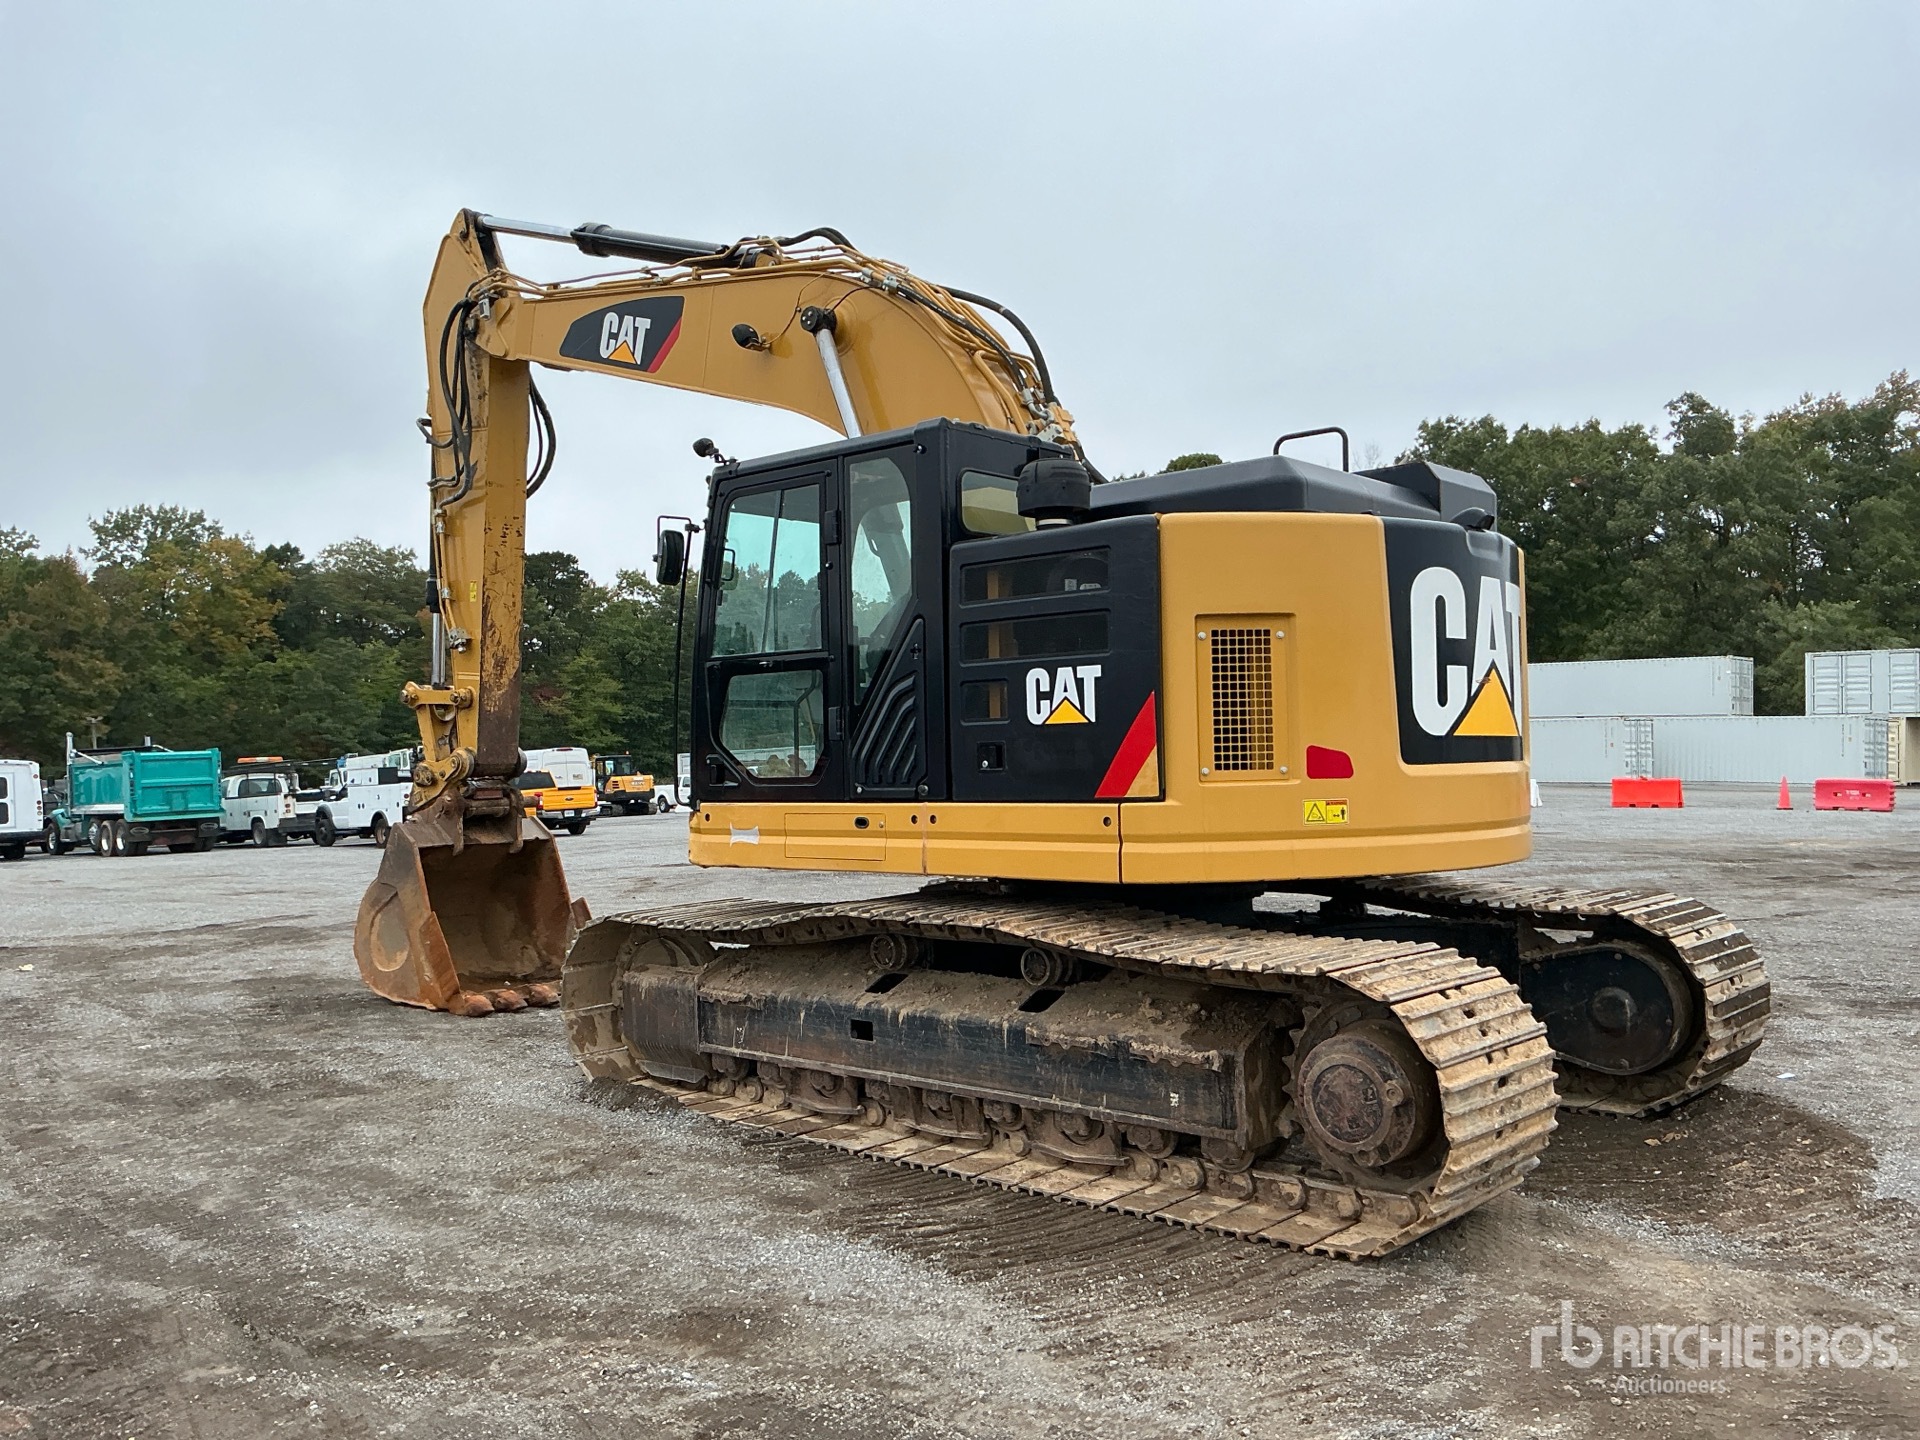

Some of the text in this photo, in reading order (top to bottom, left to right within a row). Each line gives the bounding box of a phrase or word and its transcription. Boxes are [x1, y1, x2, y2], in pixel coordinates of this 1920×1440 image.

[600, 312, 651, 365] CAT
[1410, 566, 1522, 737] CAT
[1026, 665, 1101, 725] CAT
